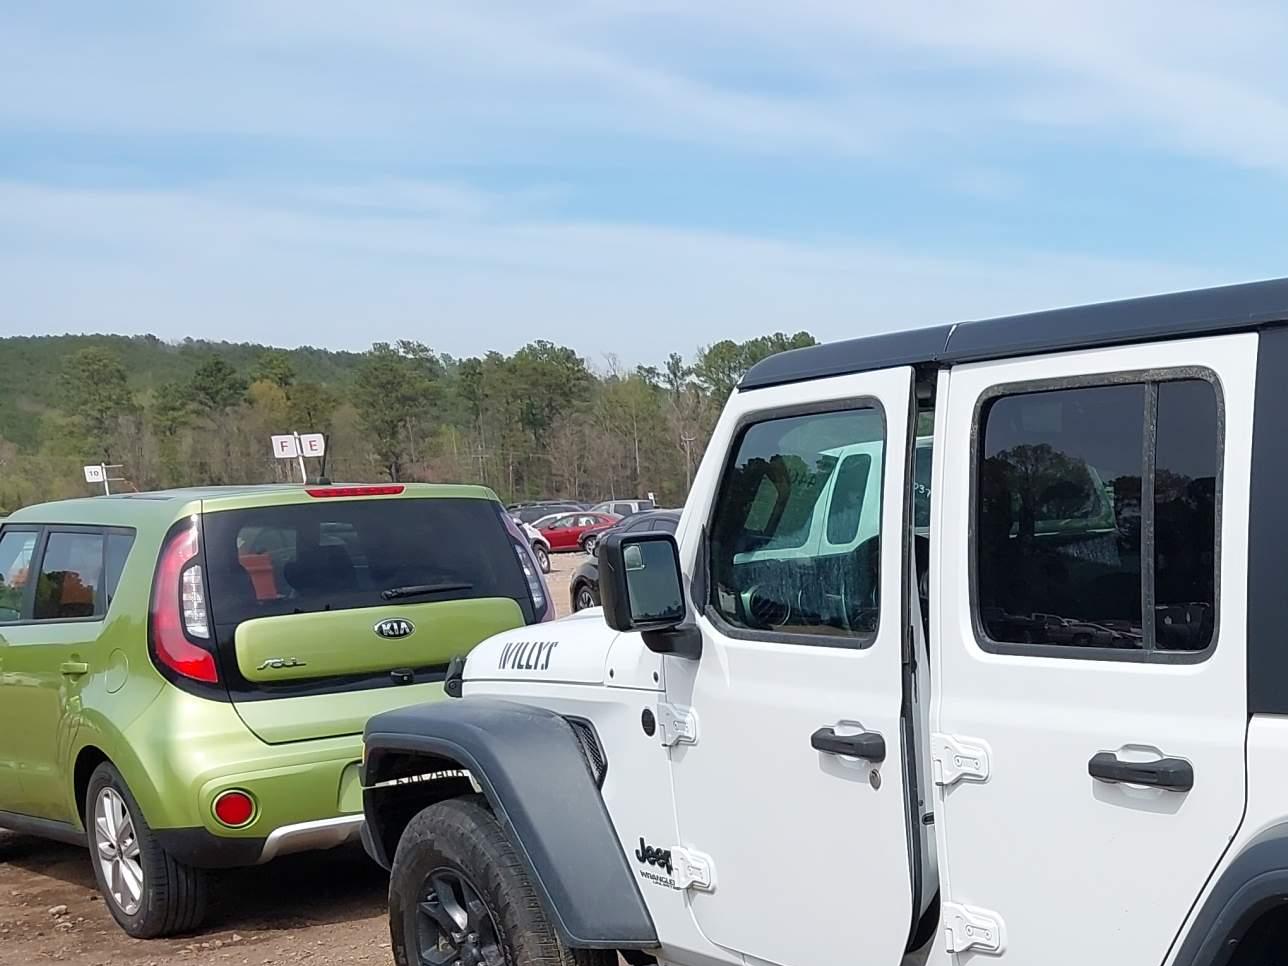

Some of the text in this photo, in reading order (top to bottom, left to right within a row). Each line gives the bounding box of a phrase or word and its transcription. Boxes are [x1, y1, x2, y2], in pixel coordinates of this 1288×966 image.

[279, 440, 289, 452] F
[308, 439, 318, 451] E
[381, 621, 410, 636] KIA
[498, 641, 559, 671] WILLYS
